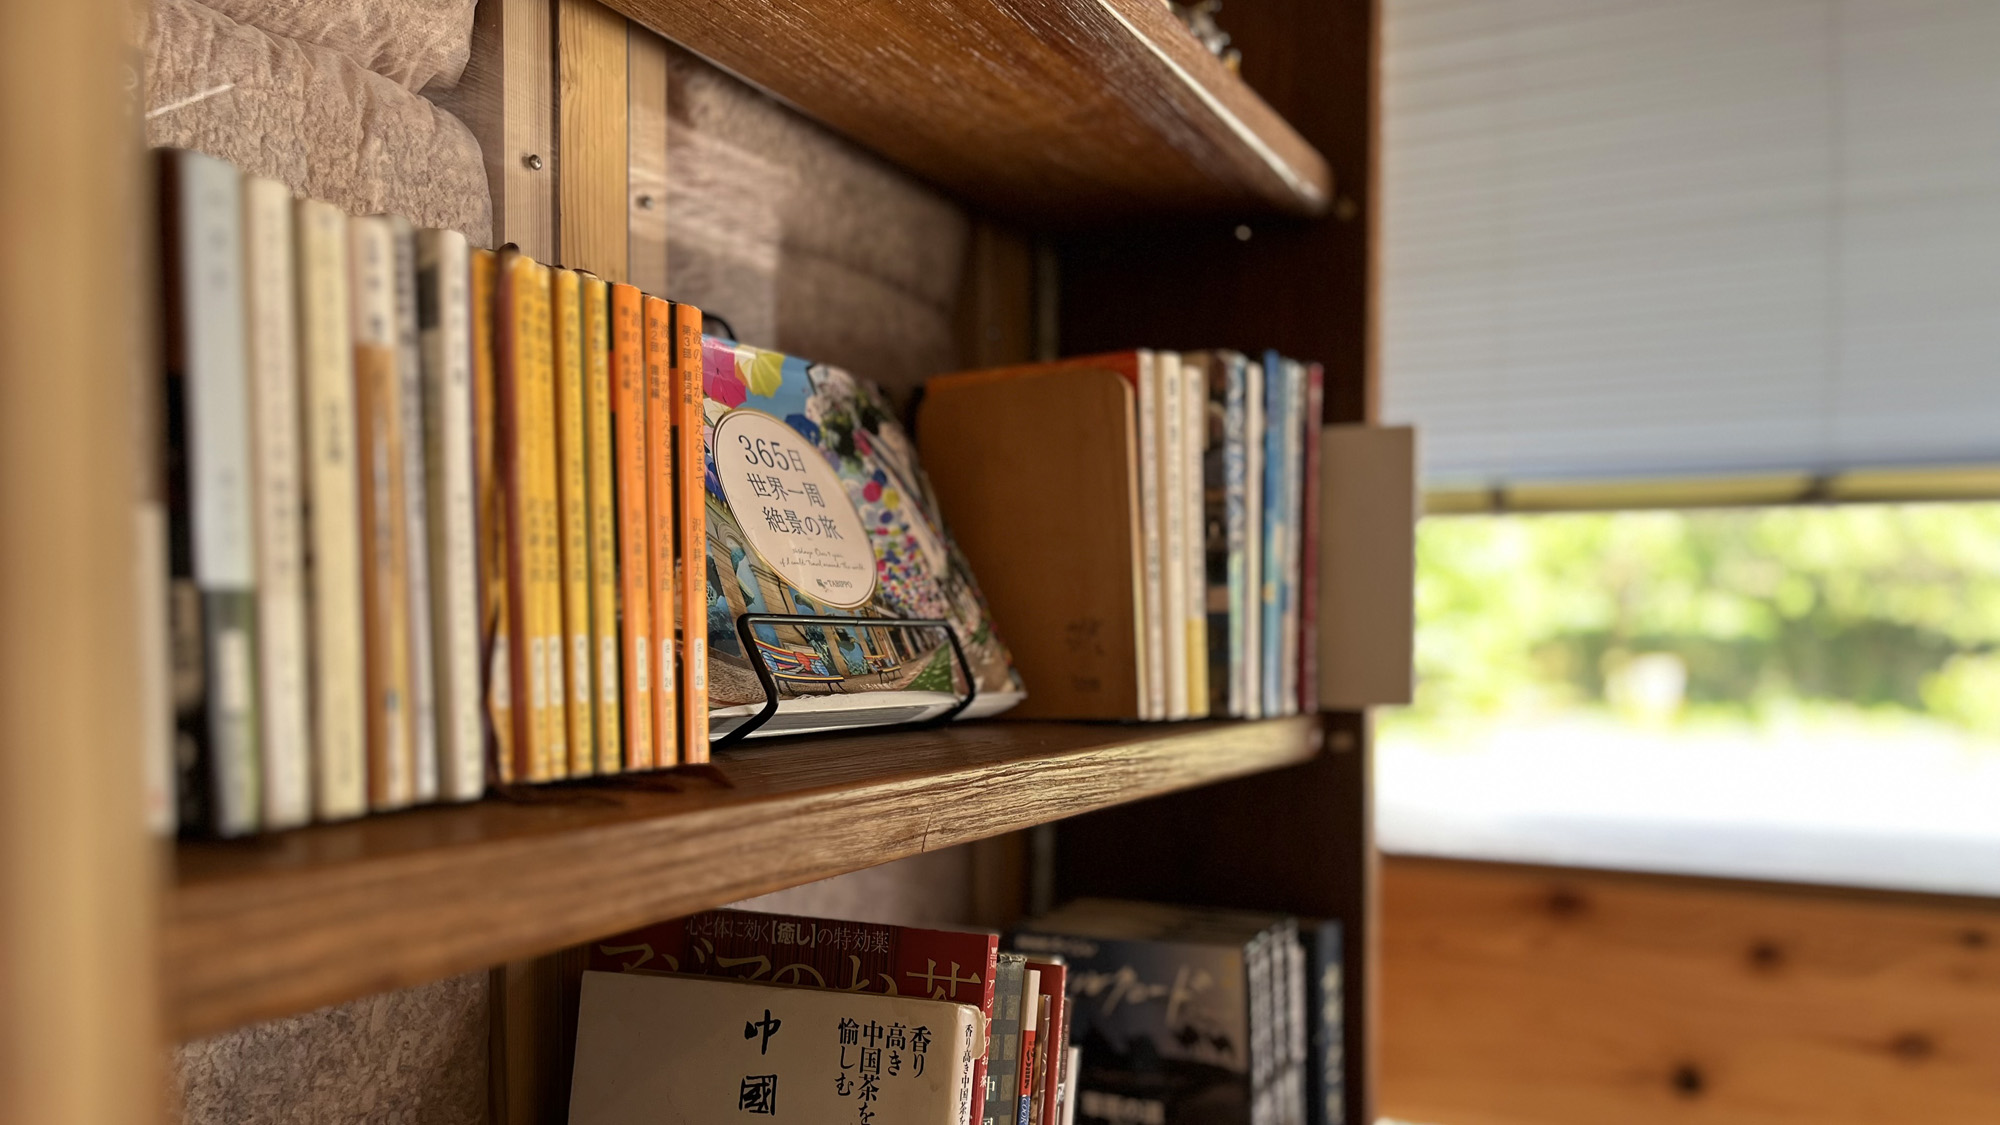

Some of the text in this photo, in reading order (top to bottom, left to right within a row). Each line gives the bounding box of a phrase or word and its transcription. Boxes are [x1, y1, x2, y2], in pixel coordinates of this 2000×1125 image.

[682, 325, 692, 359] 第3部
[692, 328, 705, 592] 波の音が消えるまで 沢木耕太郎
[738, 434, 806, 474] 365日
[746, 472, 825, 508] 世界一周
[762, 506, 844, 540] 絶景の旅
[685, 914, 889, 954] 心と体に効く【癒し】の特効薬
[835, 1017, 860, 1096] 愉しむ
[857, 1019, 884, 1125] 中国茶を
[886, 1022, 907, 1077] 高き
[910, 1025, 932, 1079] 香り
